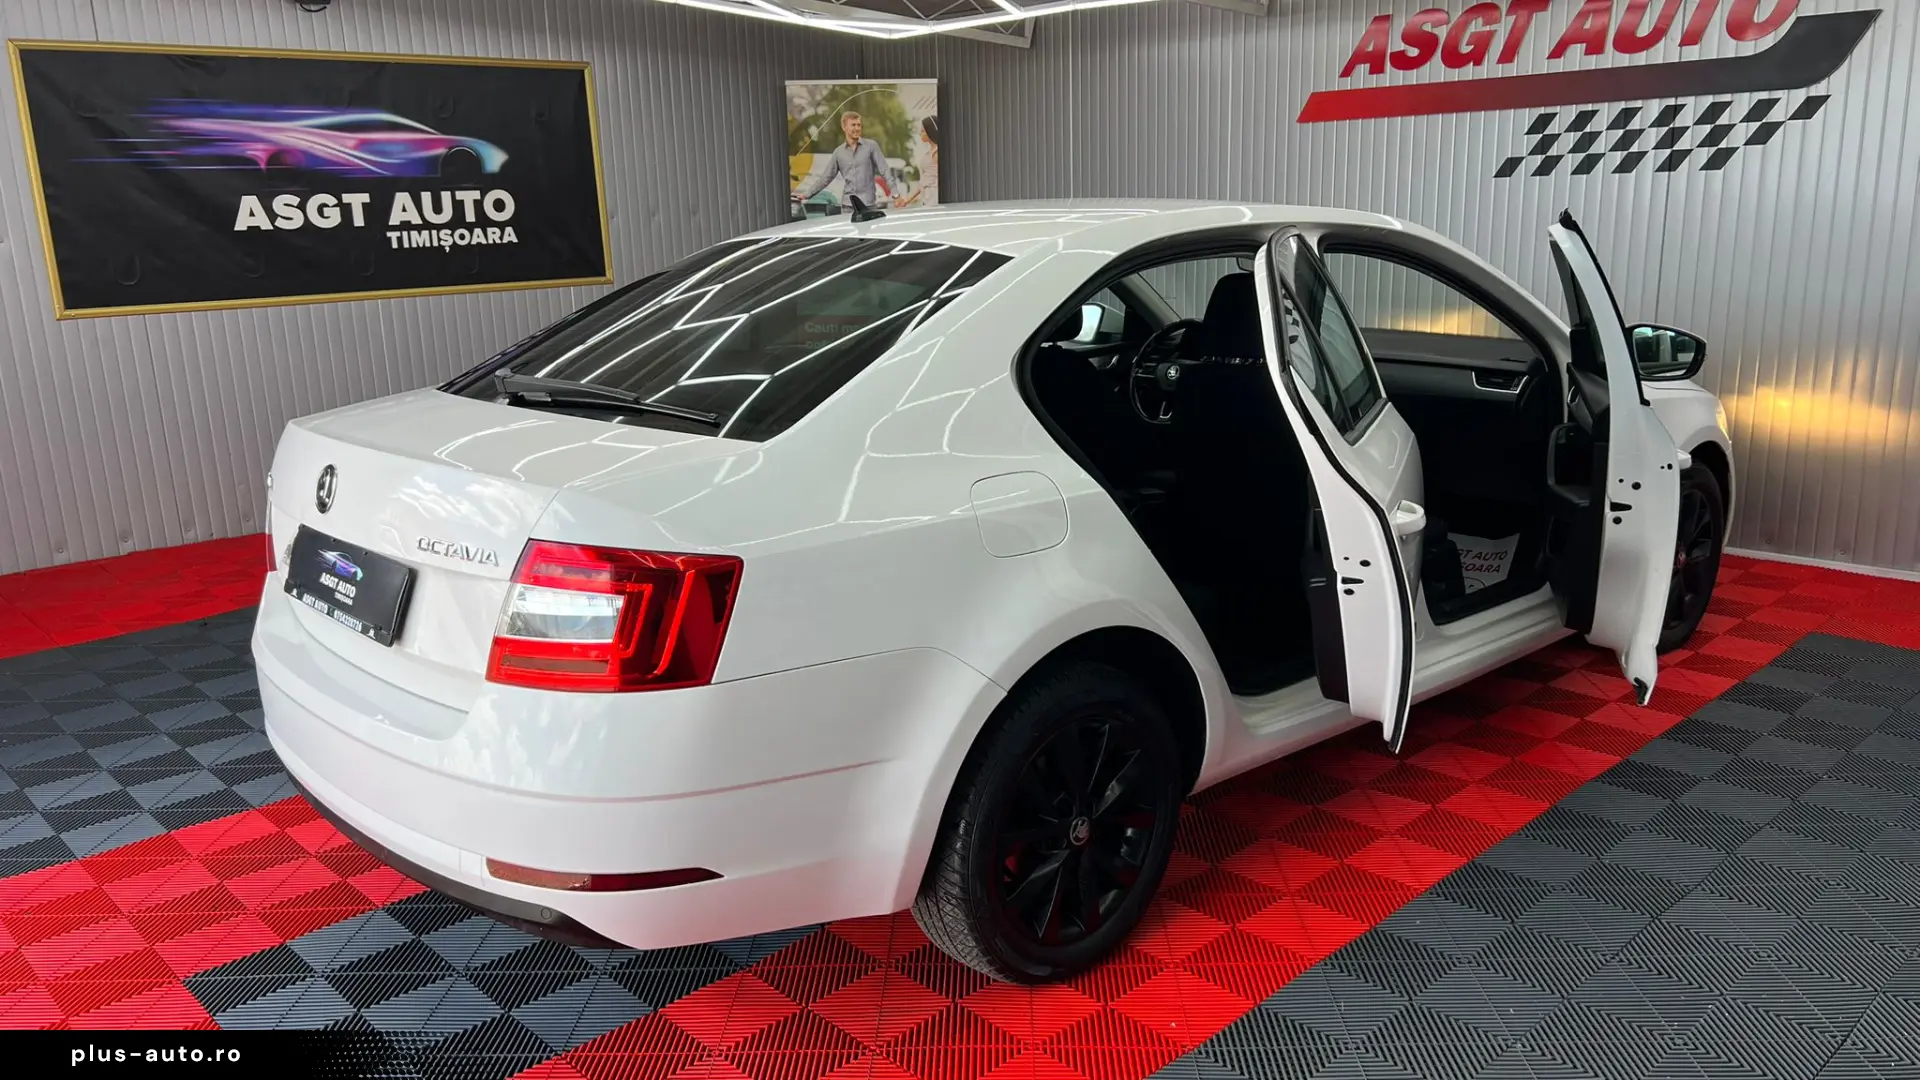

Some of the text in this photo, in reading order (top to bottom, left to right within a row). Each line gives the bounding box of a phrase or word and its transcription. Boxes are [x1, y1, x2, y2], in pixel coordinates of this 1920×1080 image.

[1339, 0, 1550, 78] ASGT
[234, 189, 516, 231] ASGT AUTO
[386, 226, 519, 253] TIMIȘOARA
[416, 536, 499, 567] OCTAVIA
[1472, 549, 1508, 561] AUTO
[319, 572, 356, 598] ASGT AUTO
[302, 593, 316, 607] ASGT
[314, 598, 329, 614] AUTO
